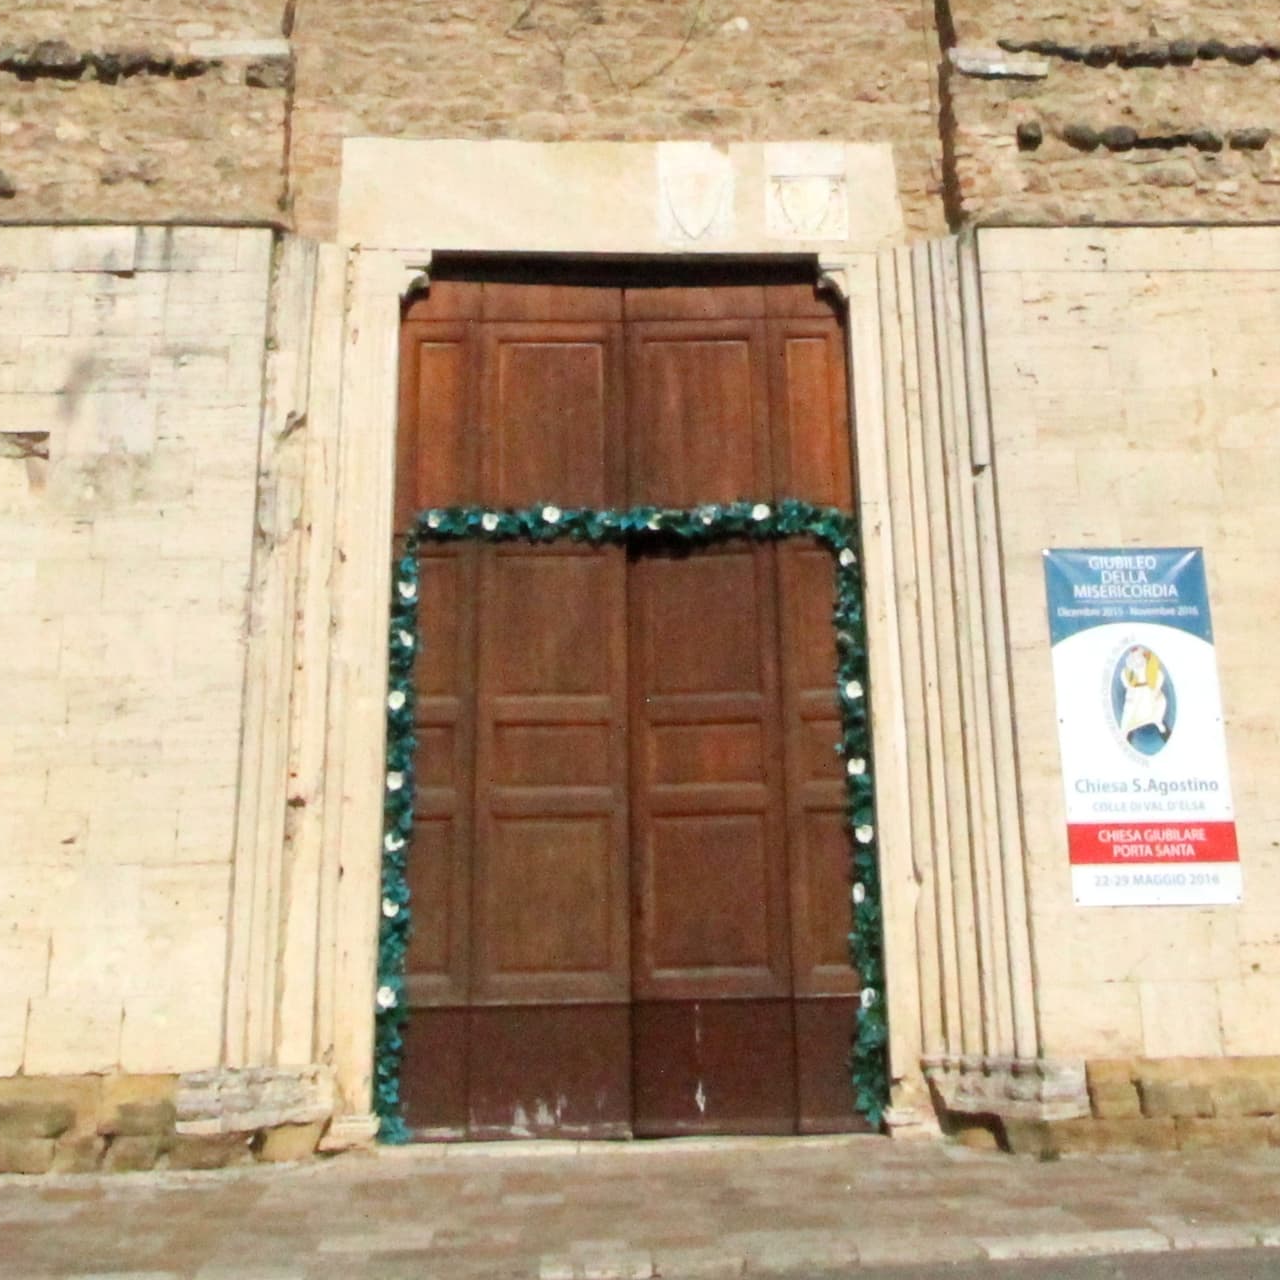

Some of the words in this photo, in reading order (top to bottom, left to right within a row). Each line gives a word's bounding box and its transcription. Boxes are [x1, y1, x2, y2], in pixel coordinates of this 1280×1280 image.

[1088, 556, 1157, 570] GIUBILEO
[1101, 570, 1148, 584] DELLA
[1074, 584, 1179, 599] MISERICORDIA
[1075, 778, 1128, 794] Chiesa
[1132, 777, 1220, 796] S.Agostino
[1092, 801, 1126, 813] COLLE
[1130, 801, 1142, 812] DI
[1098, 829, 1142, 842] CHIESA
[1144, 828, 1206, 841] GIUBILARE
[1113, 844, 1153, 857] PORTA
[1155, 844, 1195, 857] SANTA
[1132, 873, 1185, 886] MAGGIO
[1189, 872, 1220, 885] 2016
